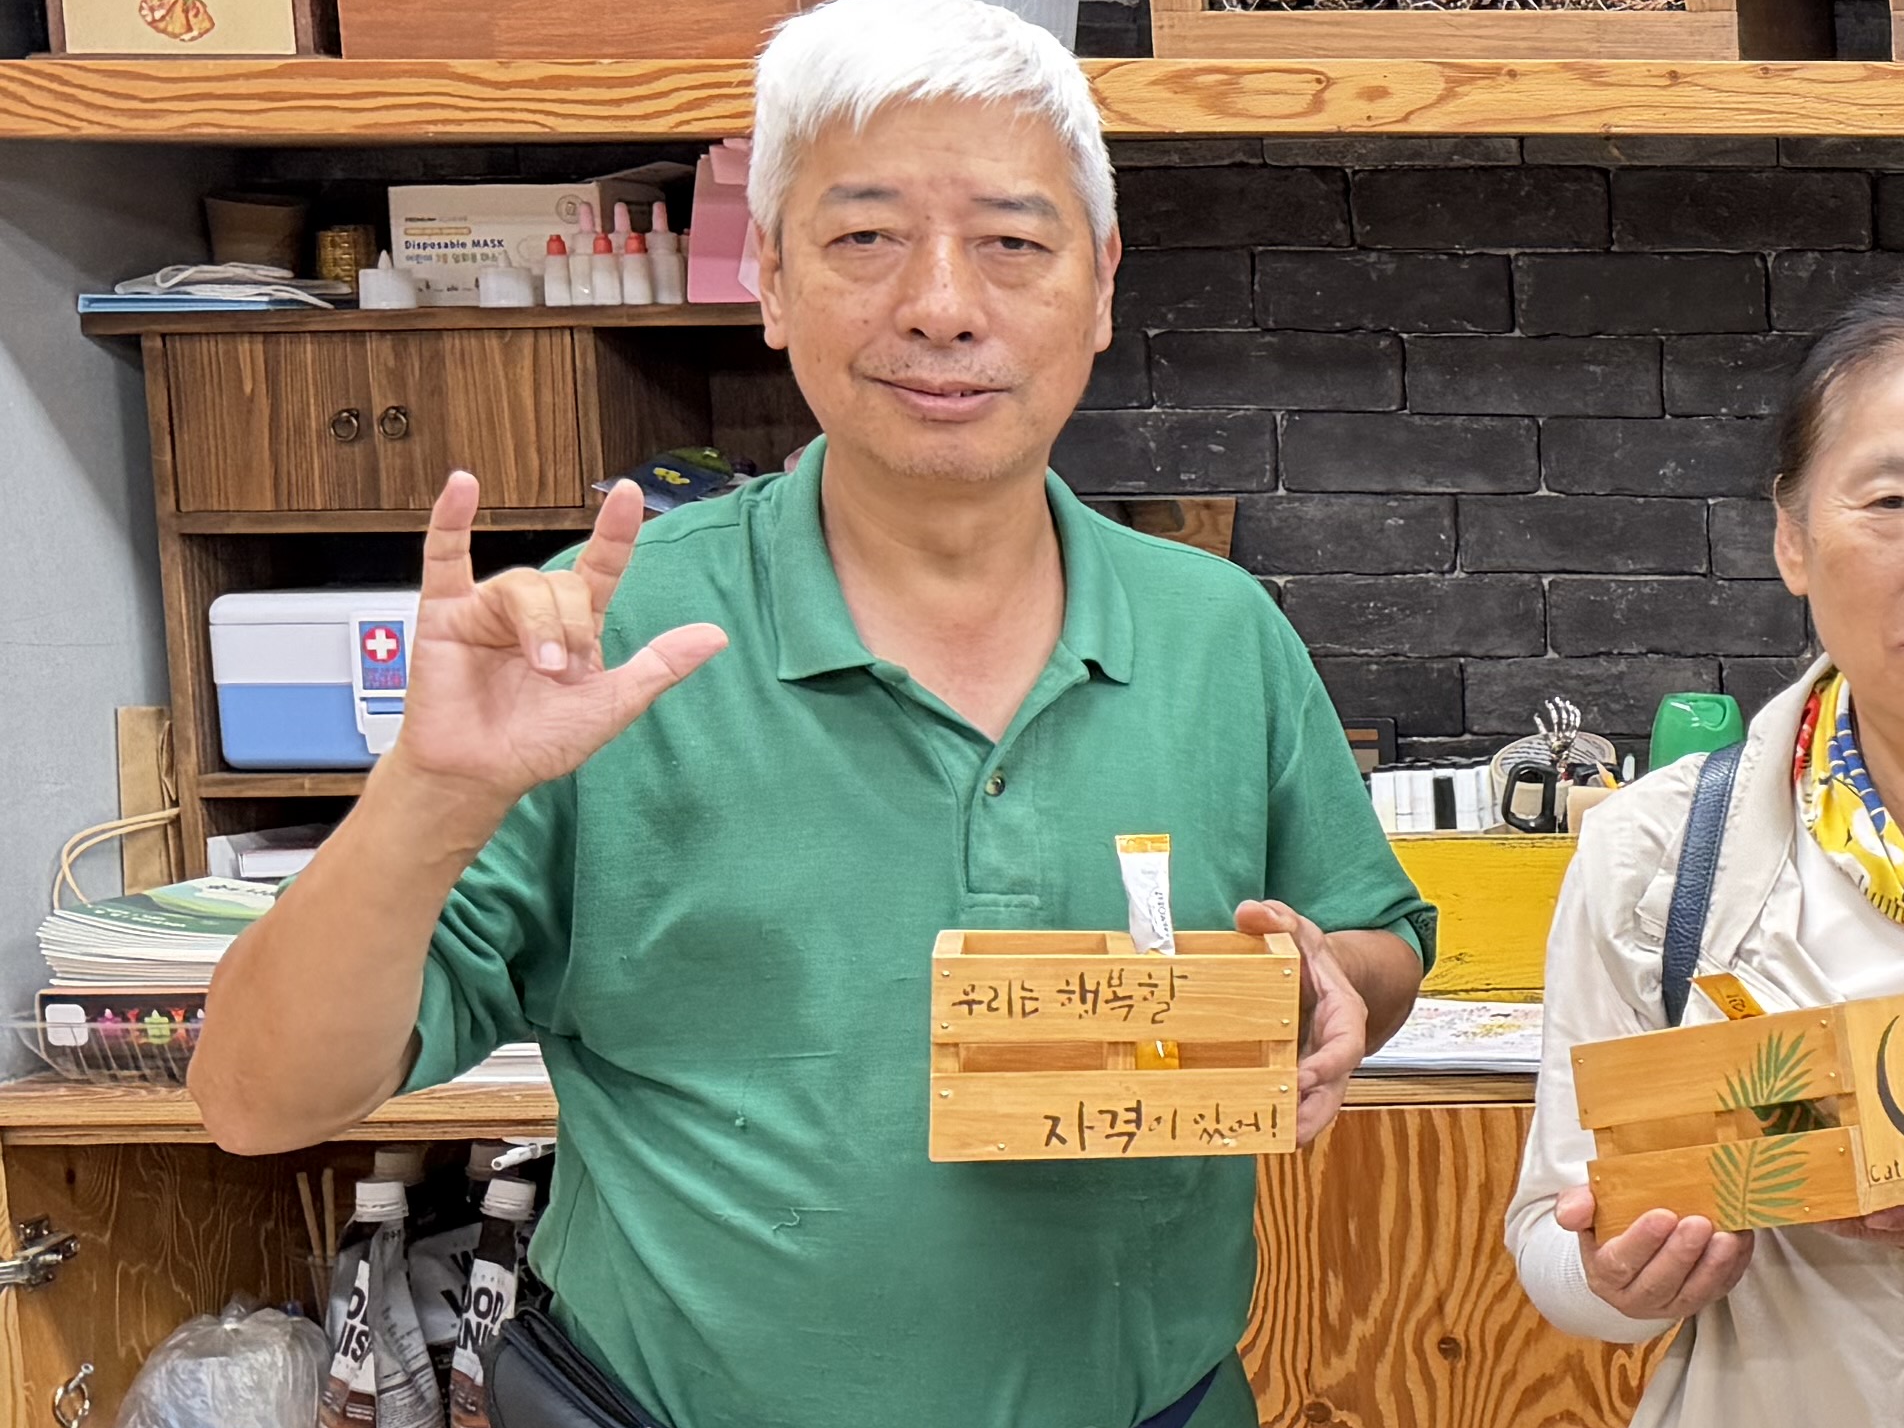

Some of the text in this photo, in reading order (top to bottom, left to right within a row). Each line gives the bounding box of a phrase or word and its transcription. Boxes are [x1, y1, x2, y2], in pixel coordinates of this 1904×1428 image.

[404, 238, 505, 251] Disposable MASK
[951, 967, 1189, 1025] 우리는 행복할
[1042, 1099, 1279, 1155] 자격이 있어!
[1870, 1159, 1902, 1183] Cat
